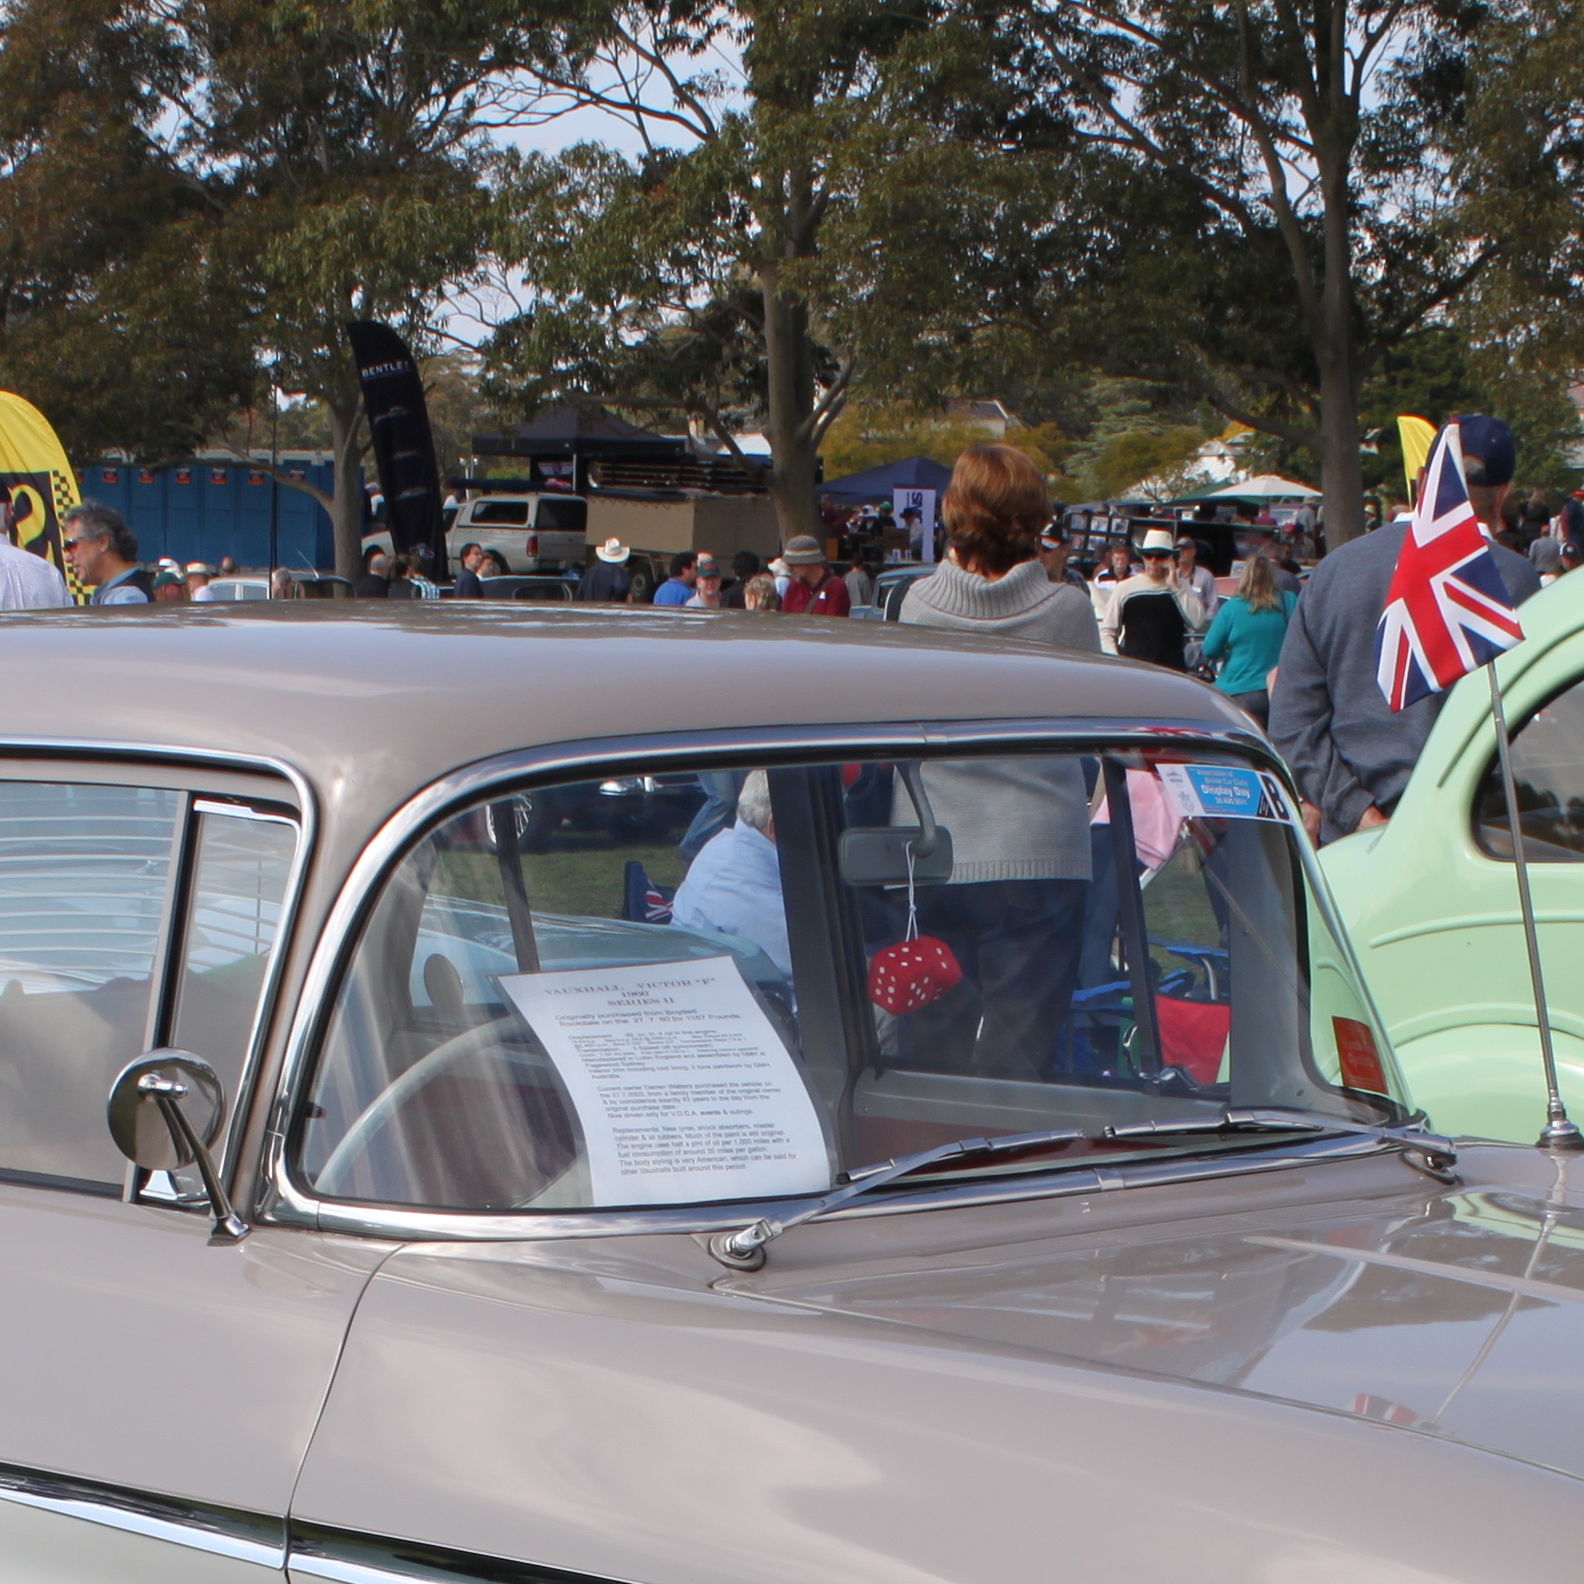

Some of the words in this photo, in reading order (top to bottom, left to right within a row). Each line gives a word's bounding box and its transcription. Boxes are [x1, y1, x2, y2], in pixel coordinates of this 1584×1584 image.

[361, 360, 408, 378] BENTLE
[1200, 784, 1232, 797] Display
[1234, 786, 1250, 798] Day
[545, 985, 624, 996] VAUXHALL
[636, 980, 691, 989] VICTOR
[607, 998, 660, 1007] SERIES
[555, 1012, 596, 1021] Originally
[598, 1010, 642, 1020] purchased
[634, 1159, 651, 1167] body
